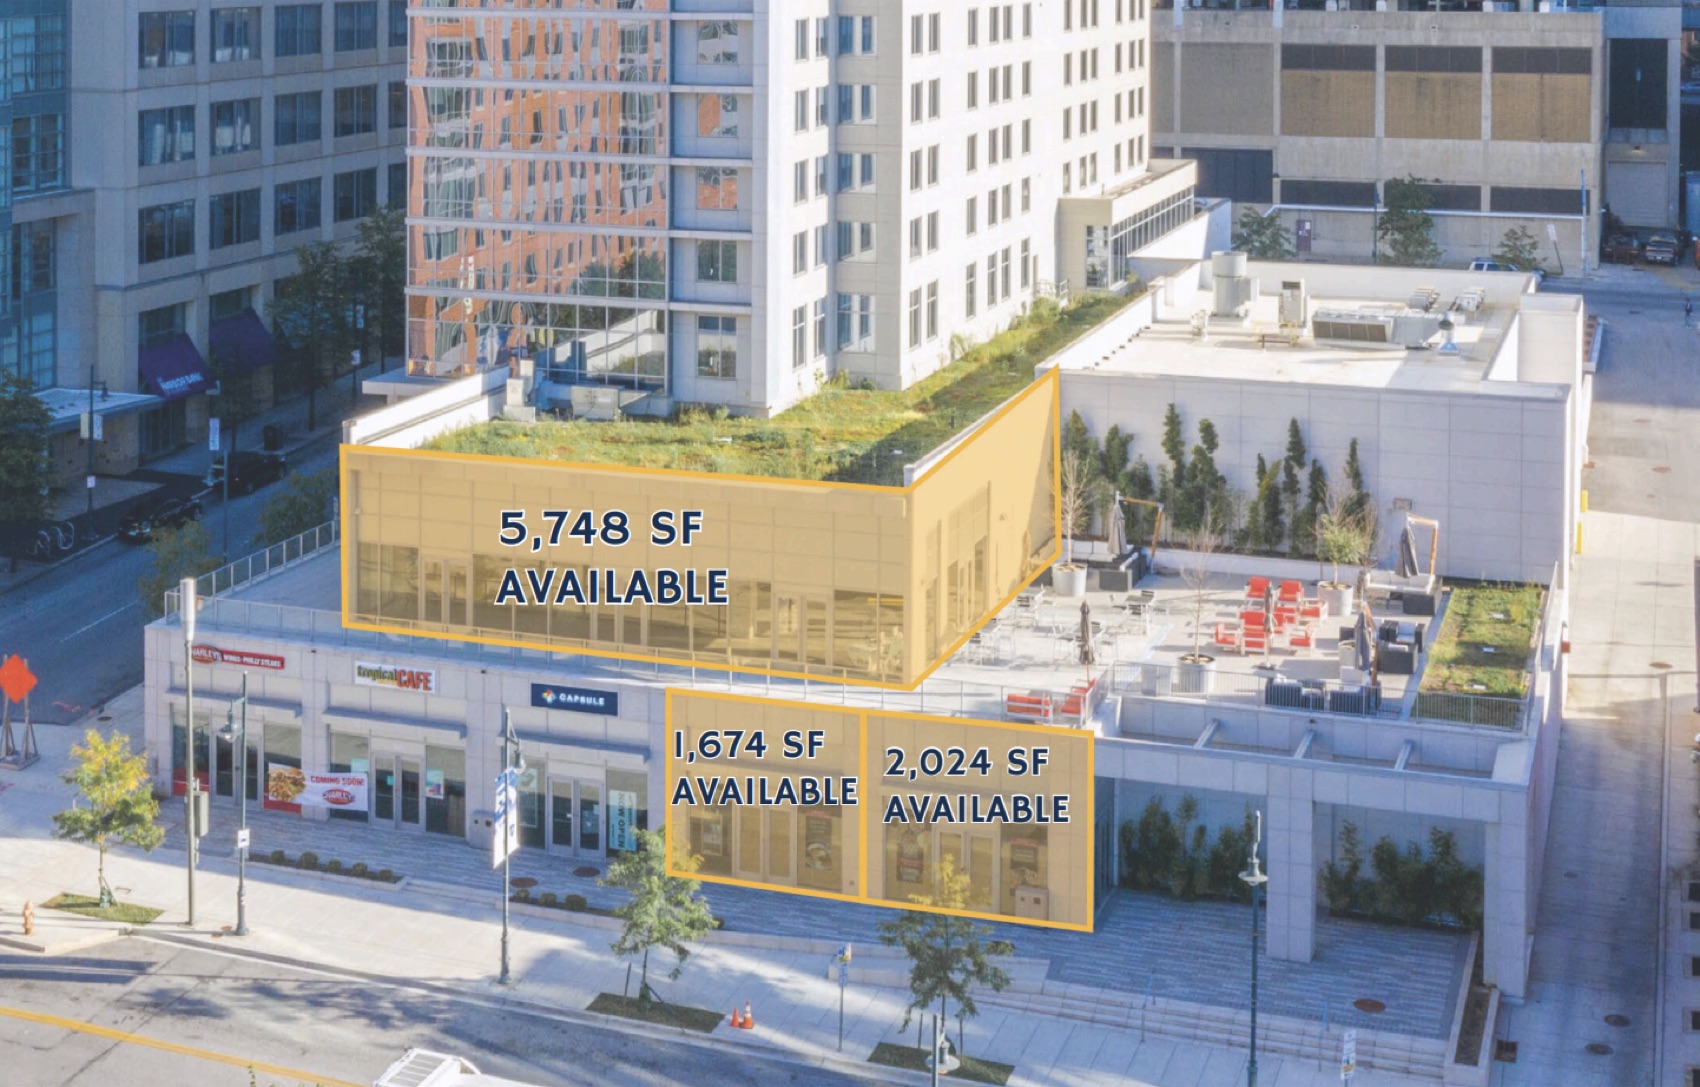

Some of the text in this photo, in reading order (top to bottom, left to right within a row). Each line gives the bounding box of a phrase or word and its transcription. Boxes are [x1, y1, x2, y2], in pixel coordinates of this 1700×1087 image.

[396, 668, 433, 691] CAFE
[559, 692, 605, 707] CAPSULE
[310, 775, 340, 785] COMING
[618, 819, 626, 849] OPEN
